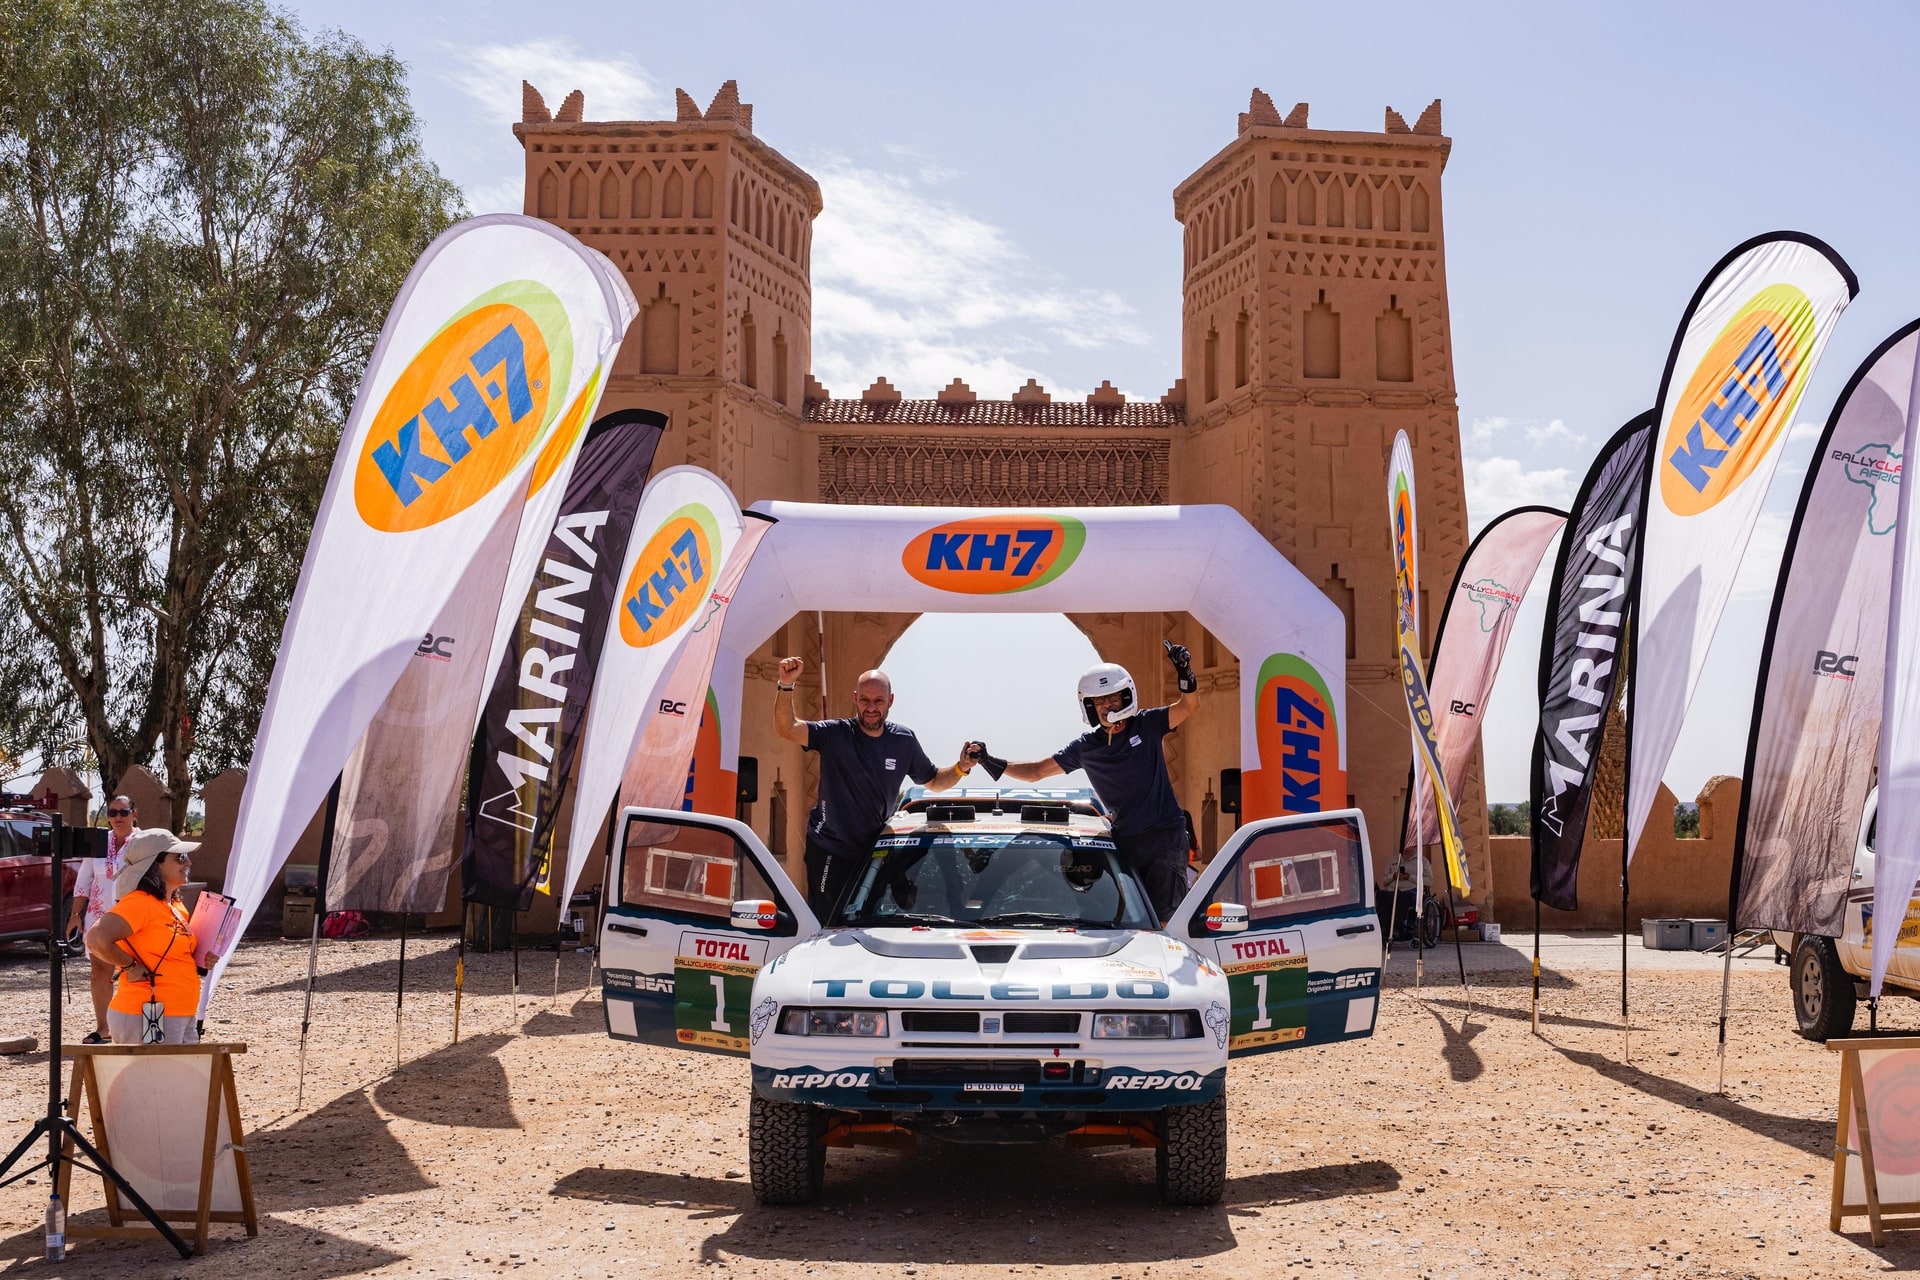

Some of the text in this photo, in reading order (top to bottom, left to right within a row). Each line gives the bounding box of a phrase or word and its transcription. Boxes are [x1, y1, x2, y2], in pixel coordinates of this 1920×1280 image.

[1831, 449, 1903, 474] RALLYCLA
[1859, 467, 1901, 485] AFRIC
[479, 510, 611, 833] MARINA
[1541, 512, 1632, 838] MARINA
[879, 838, 919, 848] Trident
[932, 837, 974, 845] SEAT
[1074, 839, 1117, 850] Trident
[1053, 864, 1092, 873] RECARO
[739, 912, 777, 921] REPSOL
[1206, 915, 1240, 923] REPSOL
[695, 938, 750, 962] TOTAL
[1231, 938, 1291, 960] TOTAL
[606, 978, 632, 988] Originales
[634, 975, 675, 994] SEAT
[812, 978, 1170, 1000] TOLEDO
[1306, 984, 1332, 994] Originales
[1307, 977, 1335, 987] Recambios
[1334, 971, 1376, 990] SEAT
[709, 974, 732, 1033] 1
[1251, 974, 1273, 1031] 1
[1105, 1074, 1205, 1091] REPSOL
